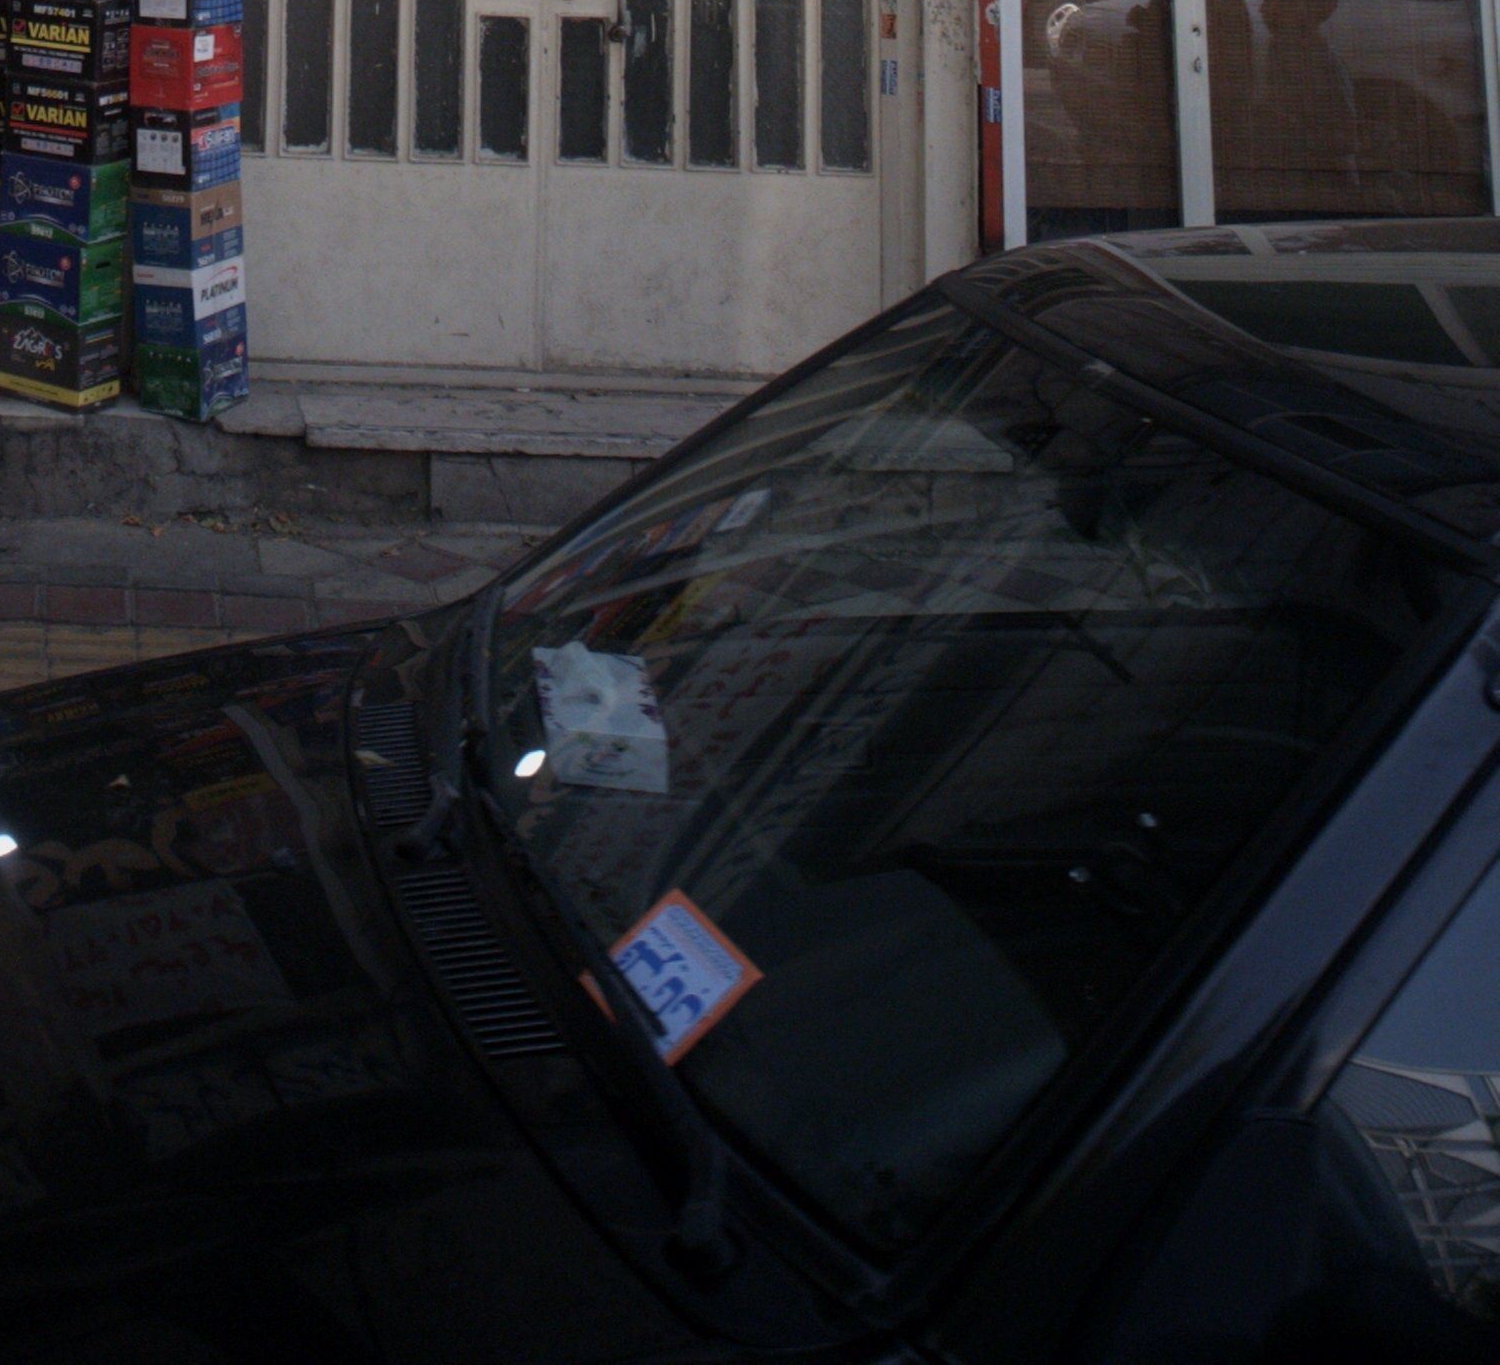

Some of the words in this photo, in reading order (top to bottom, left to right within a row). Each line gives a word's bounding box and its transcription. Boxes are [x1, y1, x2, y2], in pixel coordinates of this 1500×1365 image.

[28, 23, 90, 45] VARIAN
[26, 104, 87, 127] VARIAN
[200, 277, 239, 303] PLATINUM
